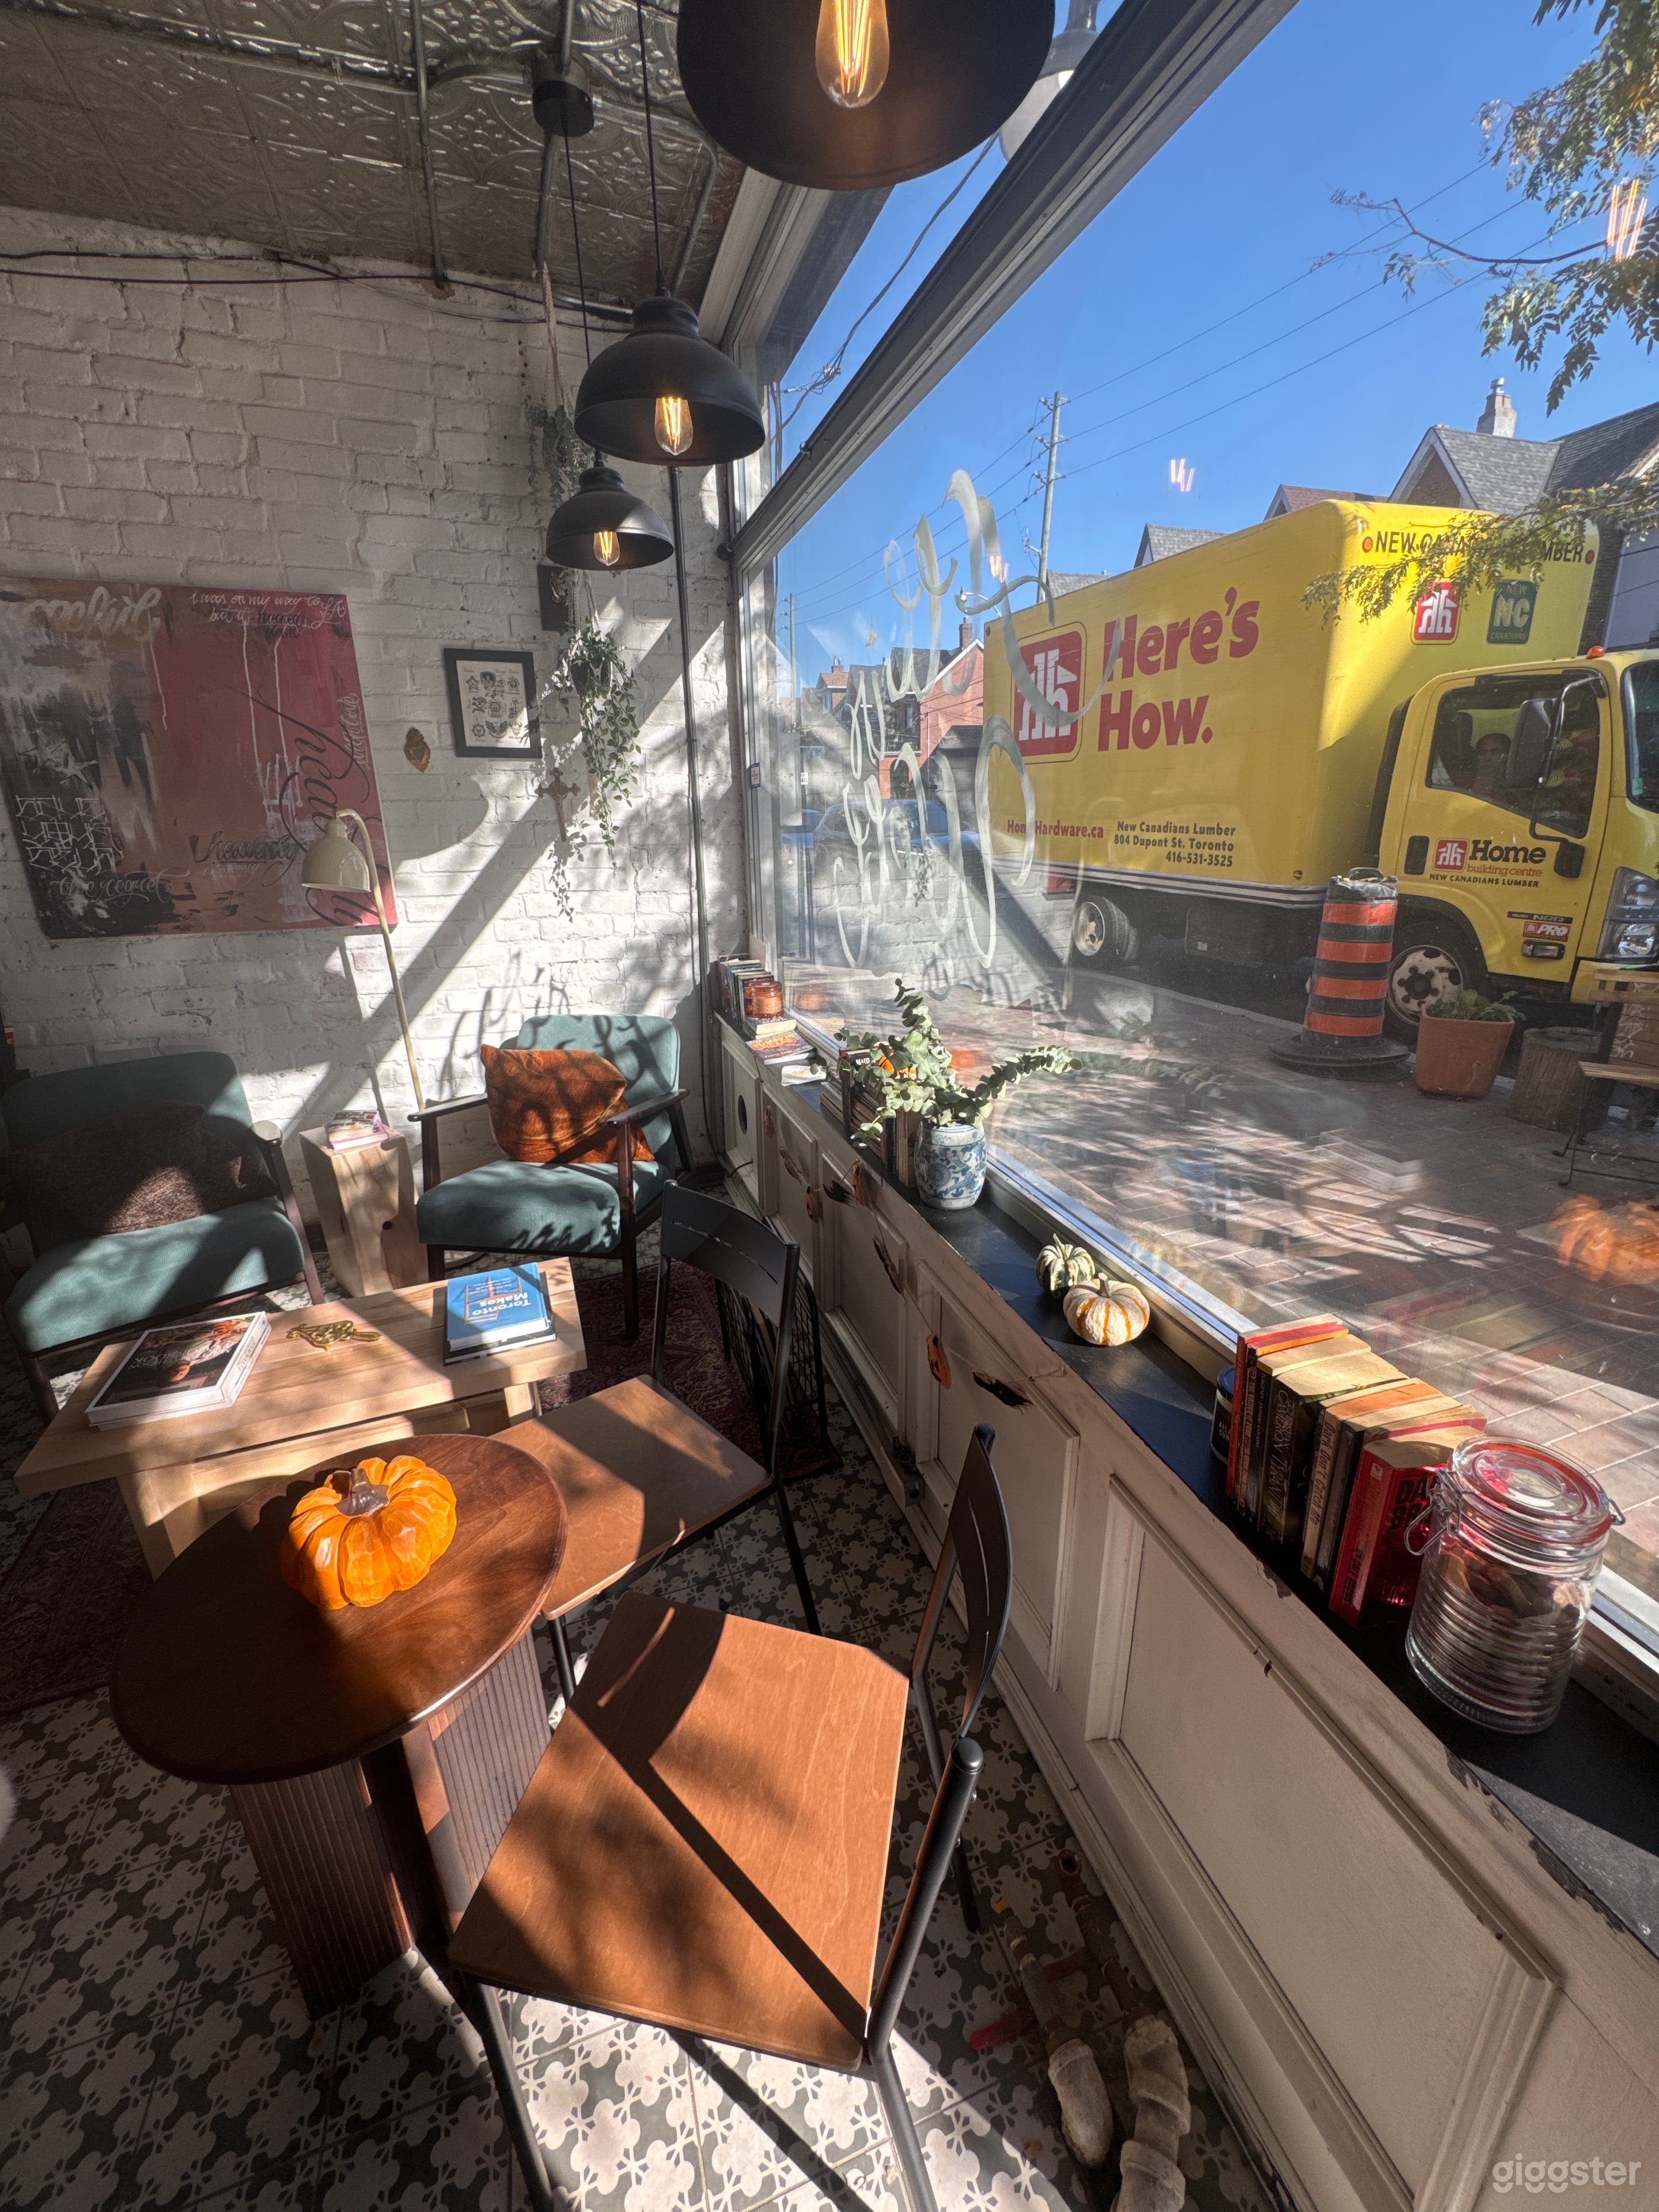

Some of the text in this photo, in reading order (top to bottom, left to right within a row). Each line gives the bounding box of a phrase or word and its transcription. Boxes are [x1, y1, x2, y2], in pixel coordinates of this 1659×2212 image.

[1375, 530, 1415, 554] NEW
[1505, 583, 1527, 595] NEW
[201, 594, 226, 605] was
[231, 594, 248, 605] on
[248, 596, 271, 612] my
[274, 596, 302, 616] way
[302, 596, 321, 607] to
[1493, 597, 1531, 628] NC
[1103, 586, 1260, 682] Here's
[1490, 631, 1527, 641] CANADIANS
[1097, 690, 1213, 752] How.
[1007, 819, 1104, 839] HomHardware.ca
[1117, 820, 1236, 836] New Canadians Lumber
[1114, 834, 1235, 853] 804 Dupont St. Toronto
[1469, 839, 1546, 863] Home
[1165, 851, 1233, 868] 416-531-3525
[1449, 874, 1499, 885] CANADIANS
[1502, 878, 1540, 888] LUMBER
[1467, 864, 1543, 877] building centre
[471, 1298, 532, 1316] Toronto
[479, 1291, 529, 1307] Makes
[1272, 1389, 1289, 1454] CAMERON
[1321, 1421, 1335, 1449] Dark
[1317, 1450, 1331, 1477] Don't
[1312, 1475, 1327, 1506] Catch
